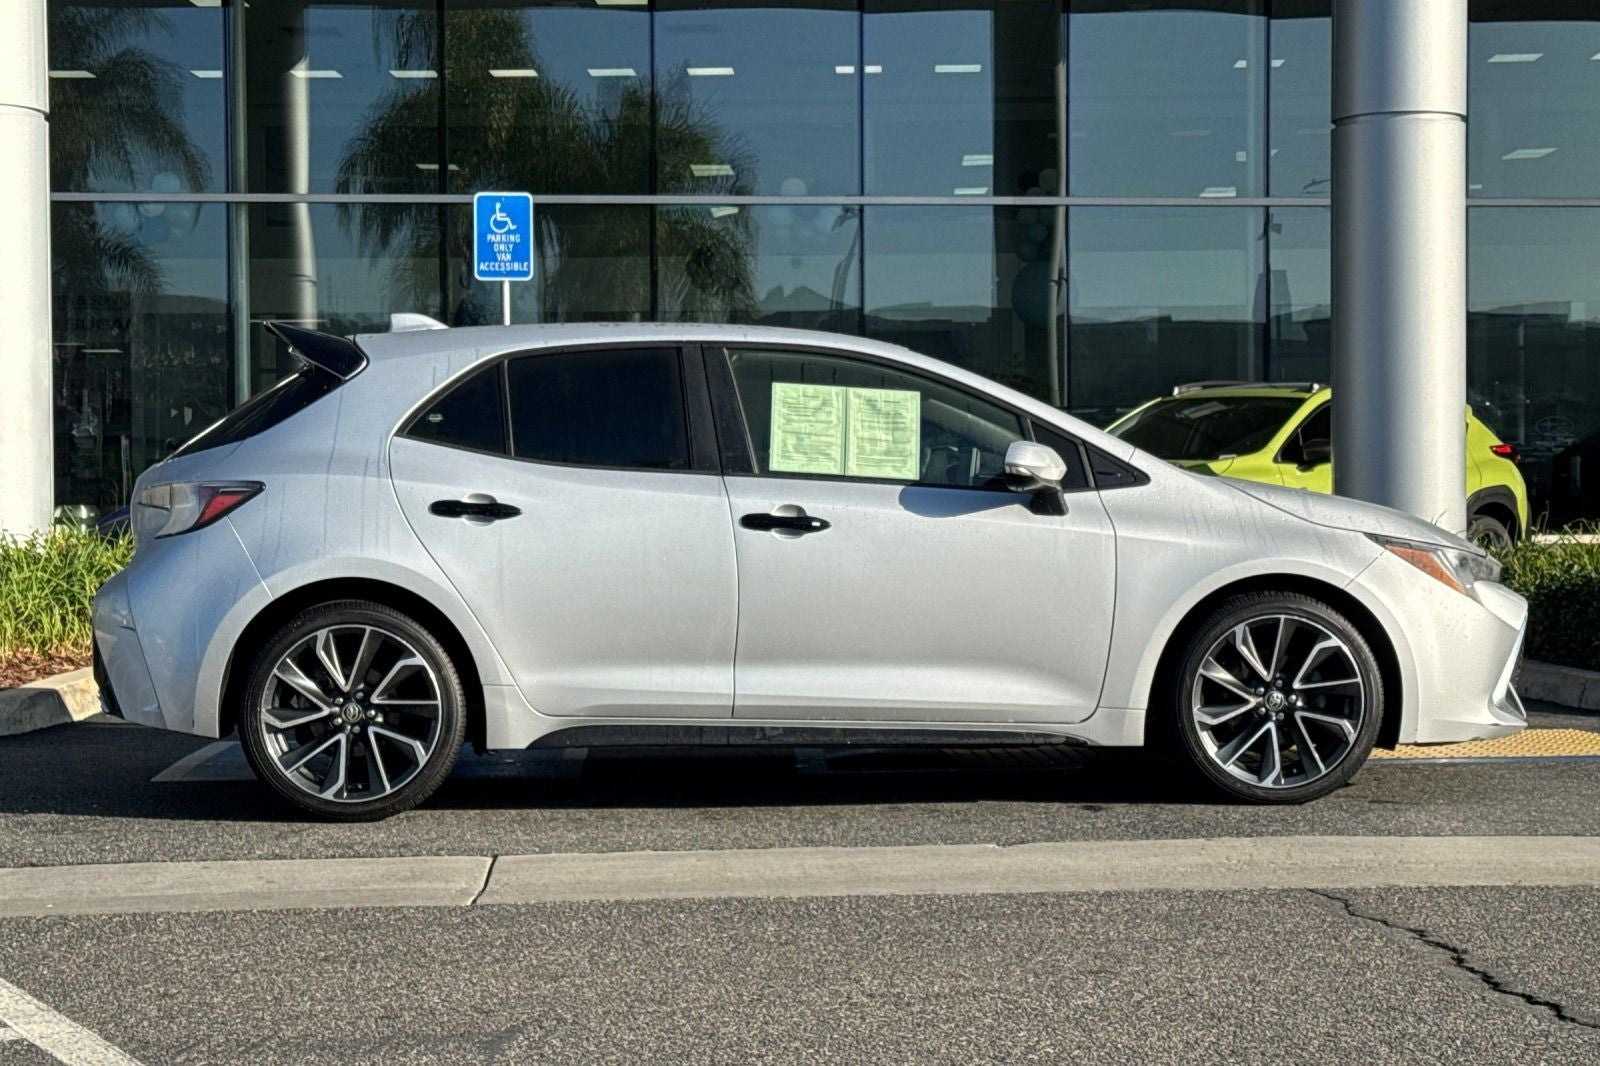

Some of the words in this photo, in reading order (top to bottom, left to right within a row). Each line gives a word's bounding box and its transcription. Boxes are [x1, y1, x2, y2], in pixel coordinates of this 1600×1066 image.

[487, 234, 520, 243] PARKING
[493, 243, 513, 252] ONLY
[496, 252, 512, 261] VAN
[479, 262, 528, 271] ACCESSIBLE
